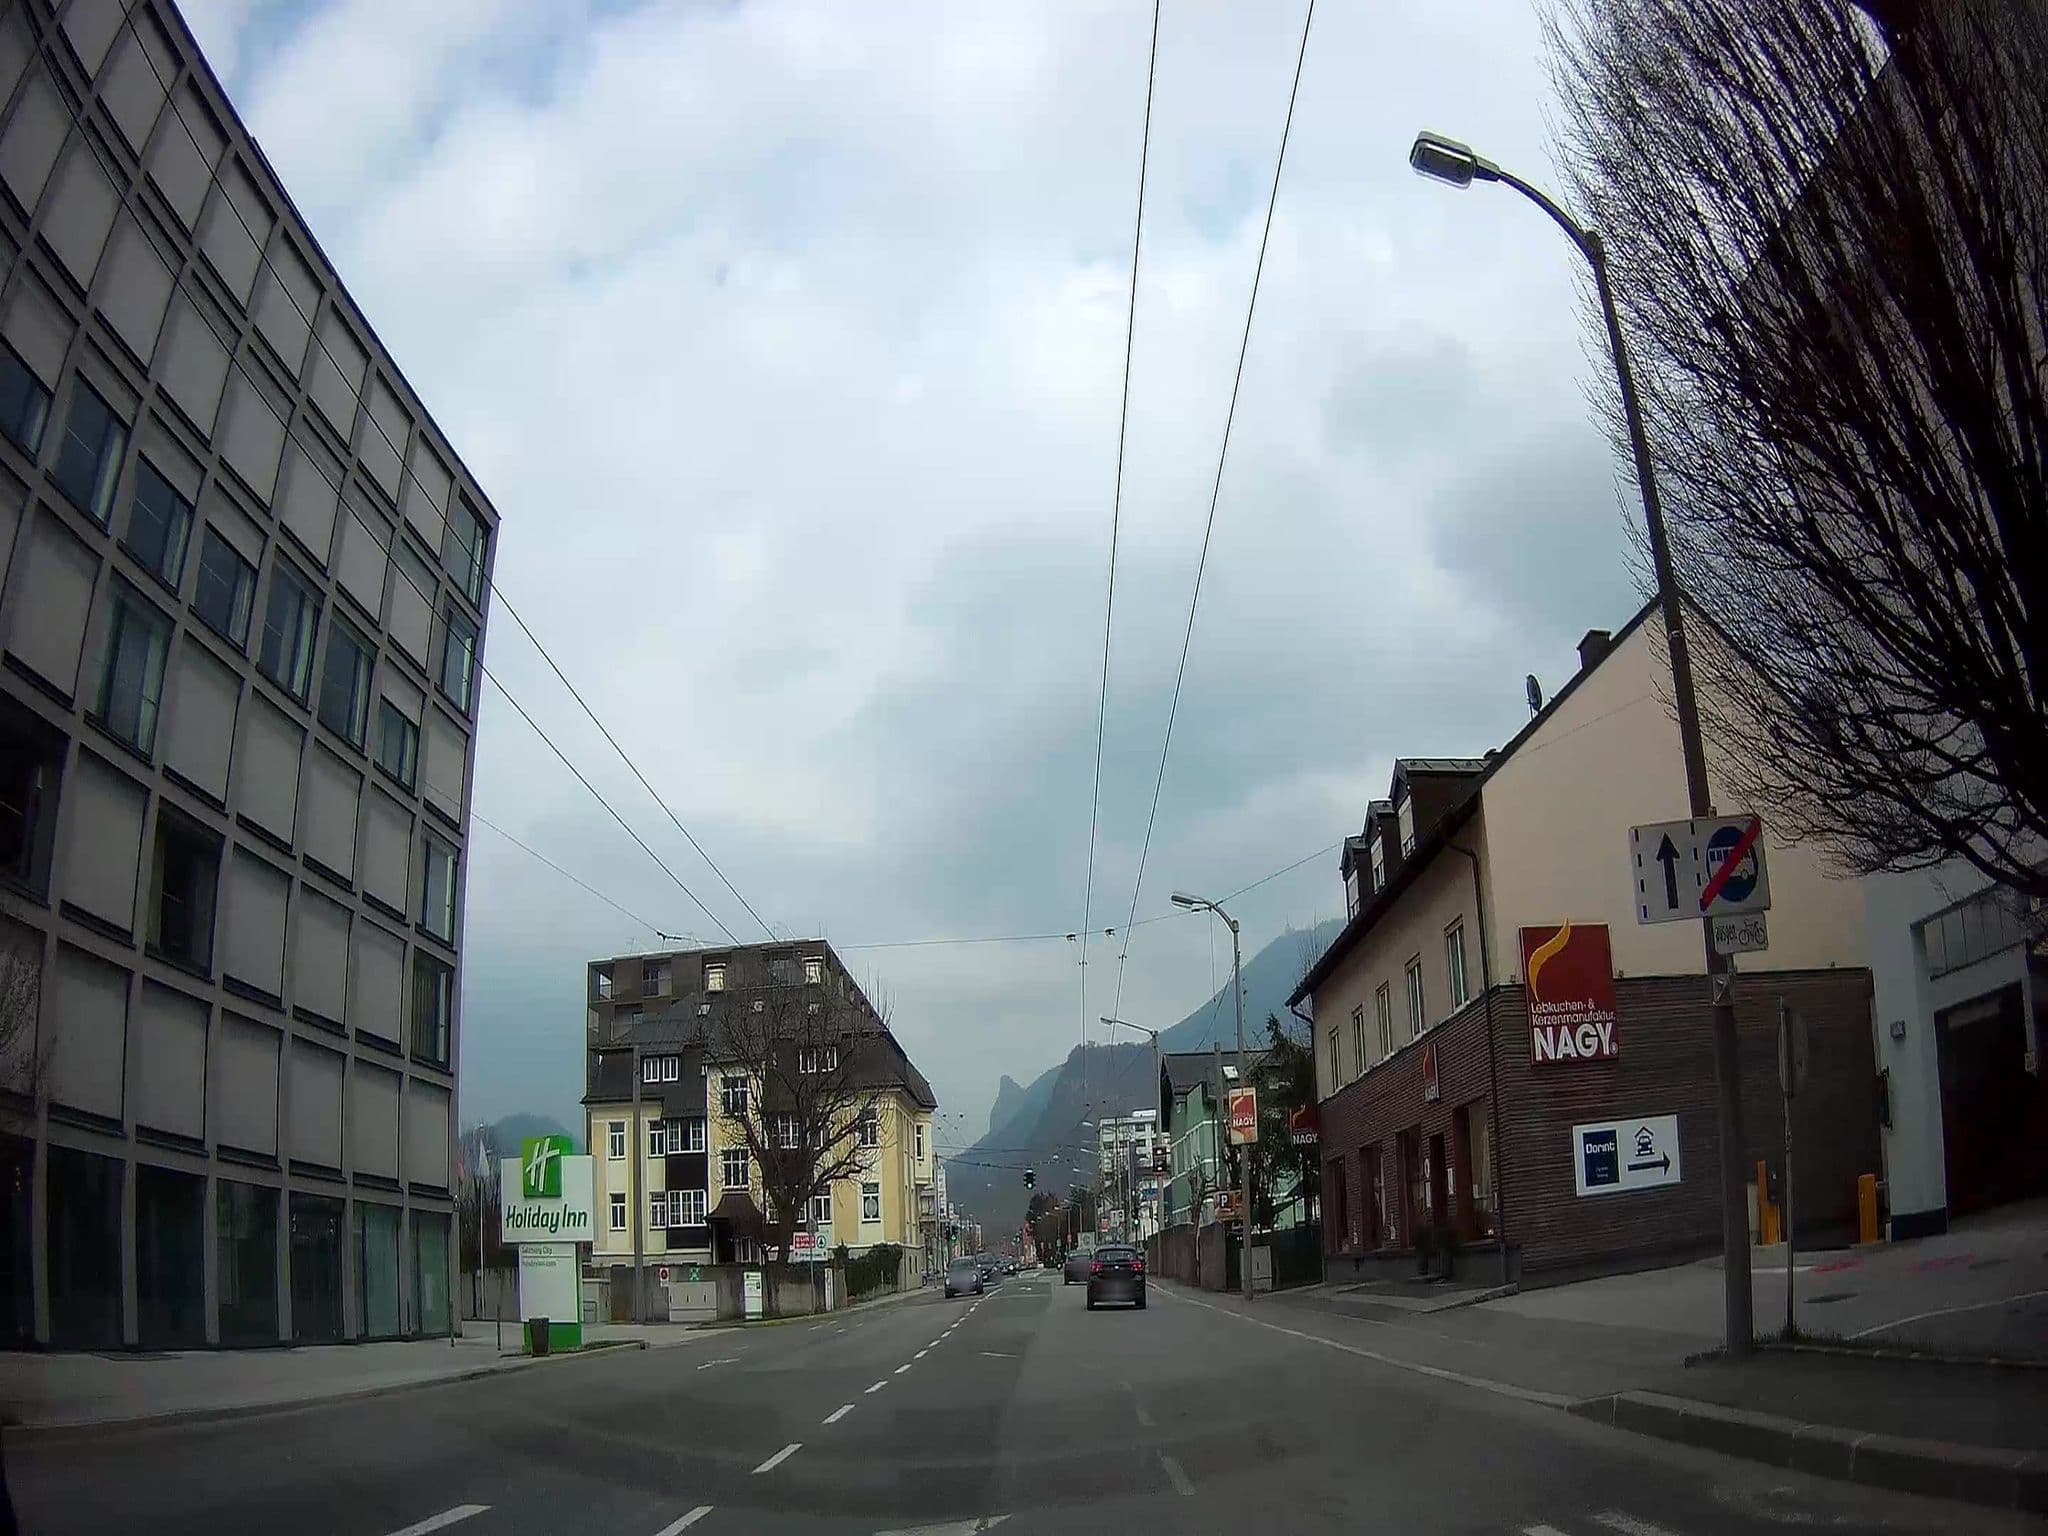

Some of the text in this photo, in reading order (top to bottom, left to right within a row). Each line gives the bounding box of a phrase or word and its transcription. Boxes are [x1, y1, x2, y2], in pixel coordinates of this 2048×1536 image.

[1587, 998, 1595, 1010] &
[1533, 1022, 1613, 1061] NAGY
[1233, 1117, 1255, 1127] NAGY
[1293, 1133, 1318, 1145] NAGY
[1221, 1195, 1228, 1207] P
[506, 1203, 588, 1233] Holiday Inn
